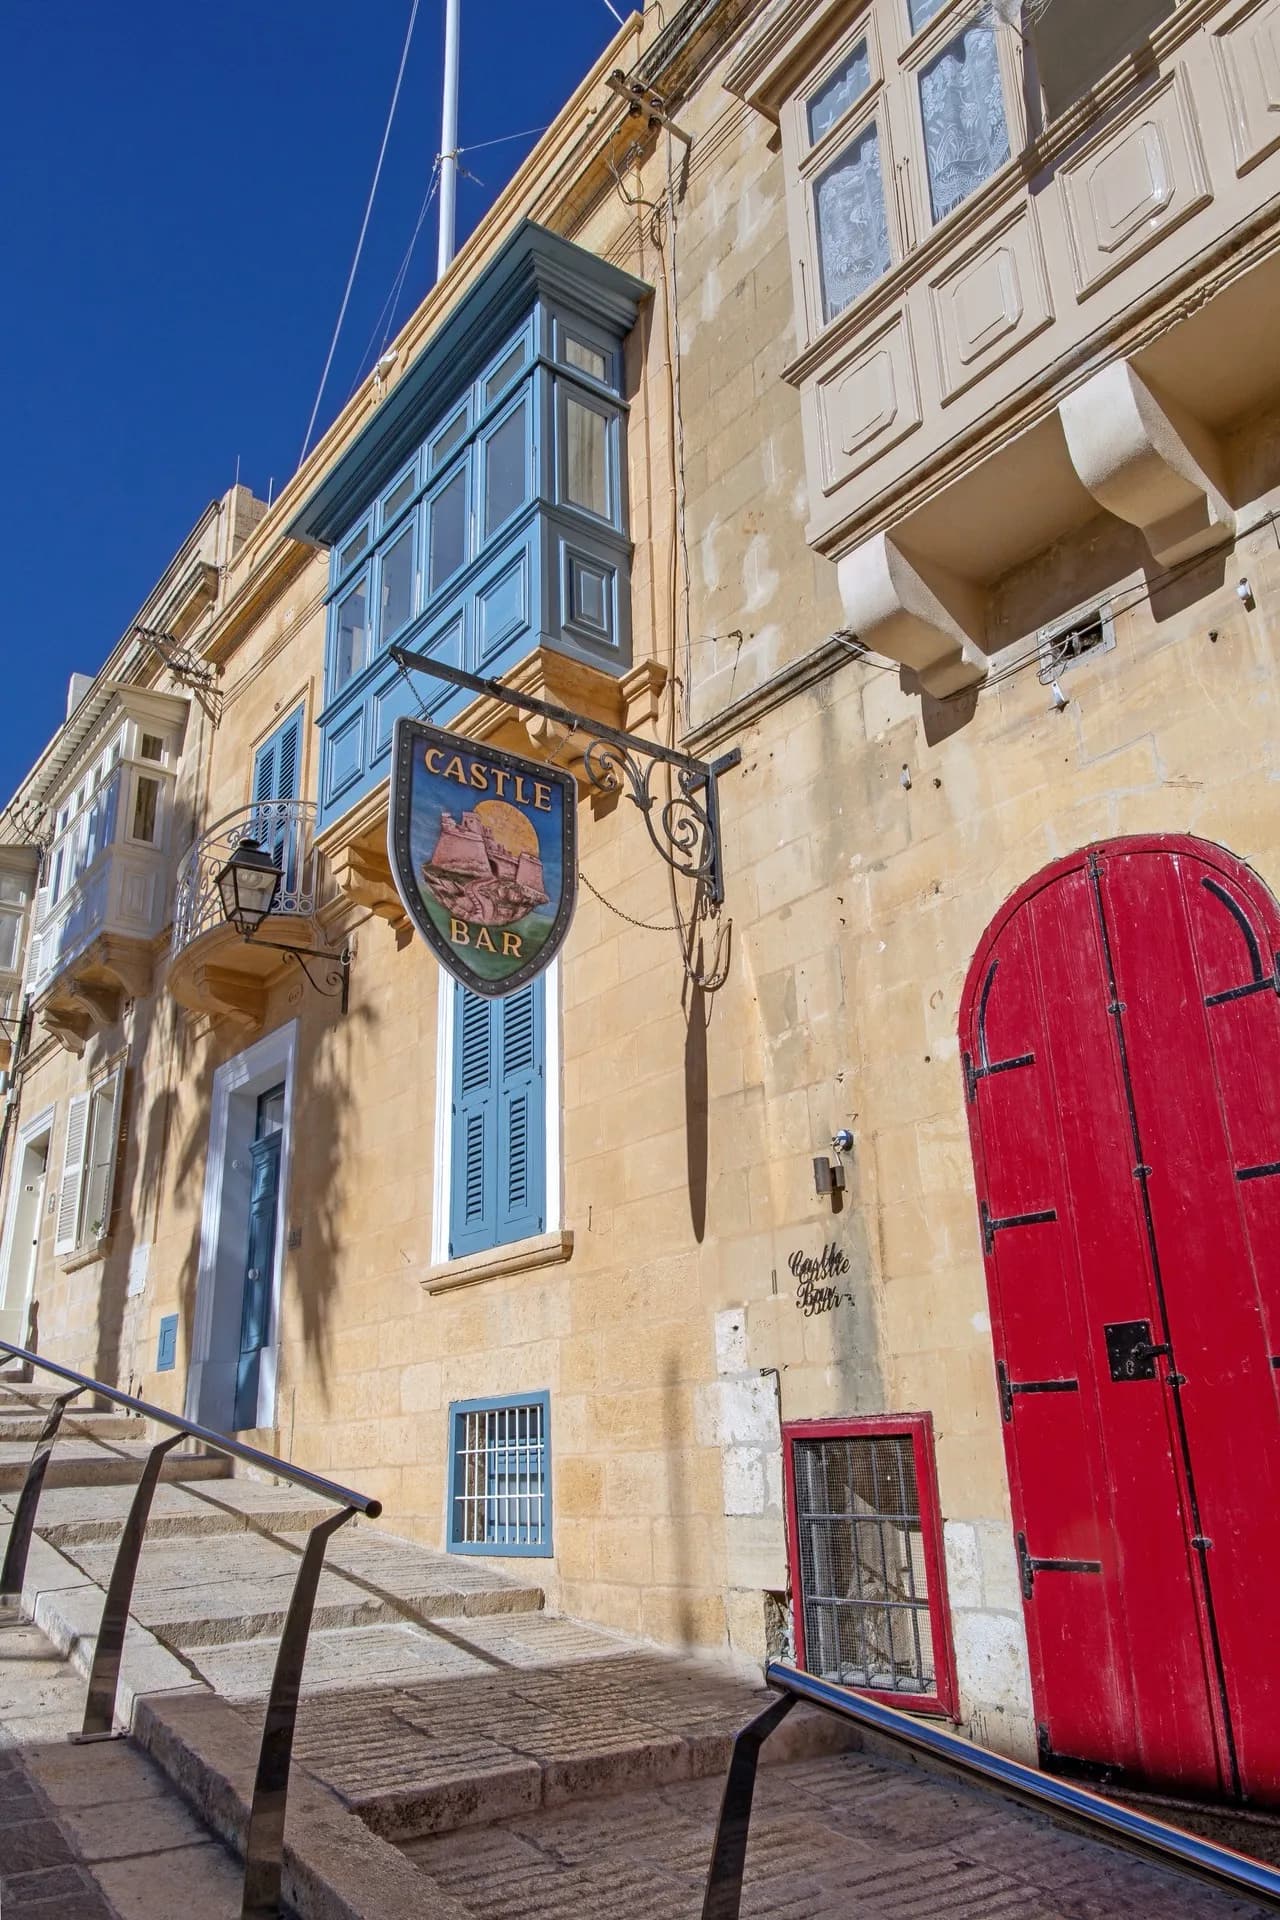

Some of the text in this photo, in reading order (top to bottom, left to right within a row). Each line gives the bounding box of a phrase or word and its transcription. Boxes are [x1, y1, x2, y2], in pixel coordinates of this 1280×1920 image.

[424, 748, 553, 812] CASTLE
[449, 919, 523, 958] BAR
[788, 1242, 850, 1284] Castle
[796, 1282, 843, 1317] Bar
